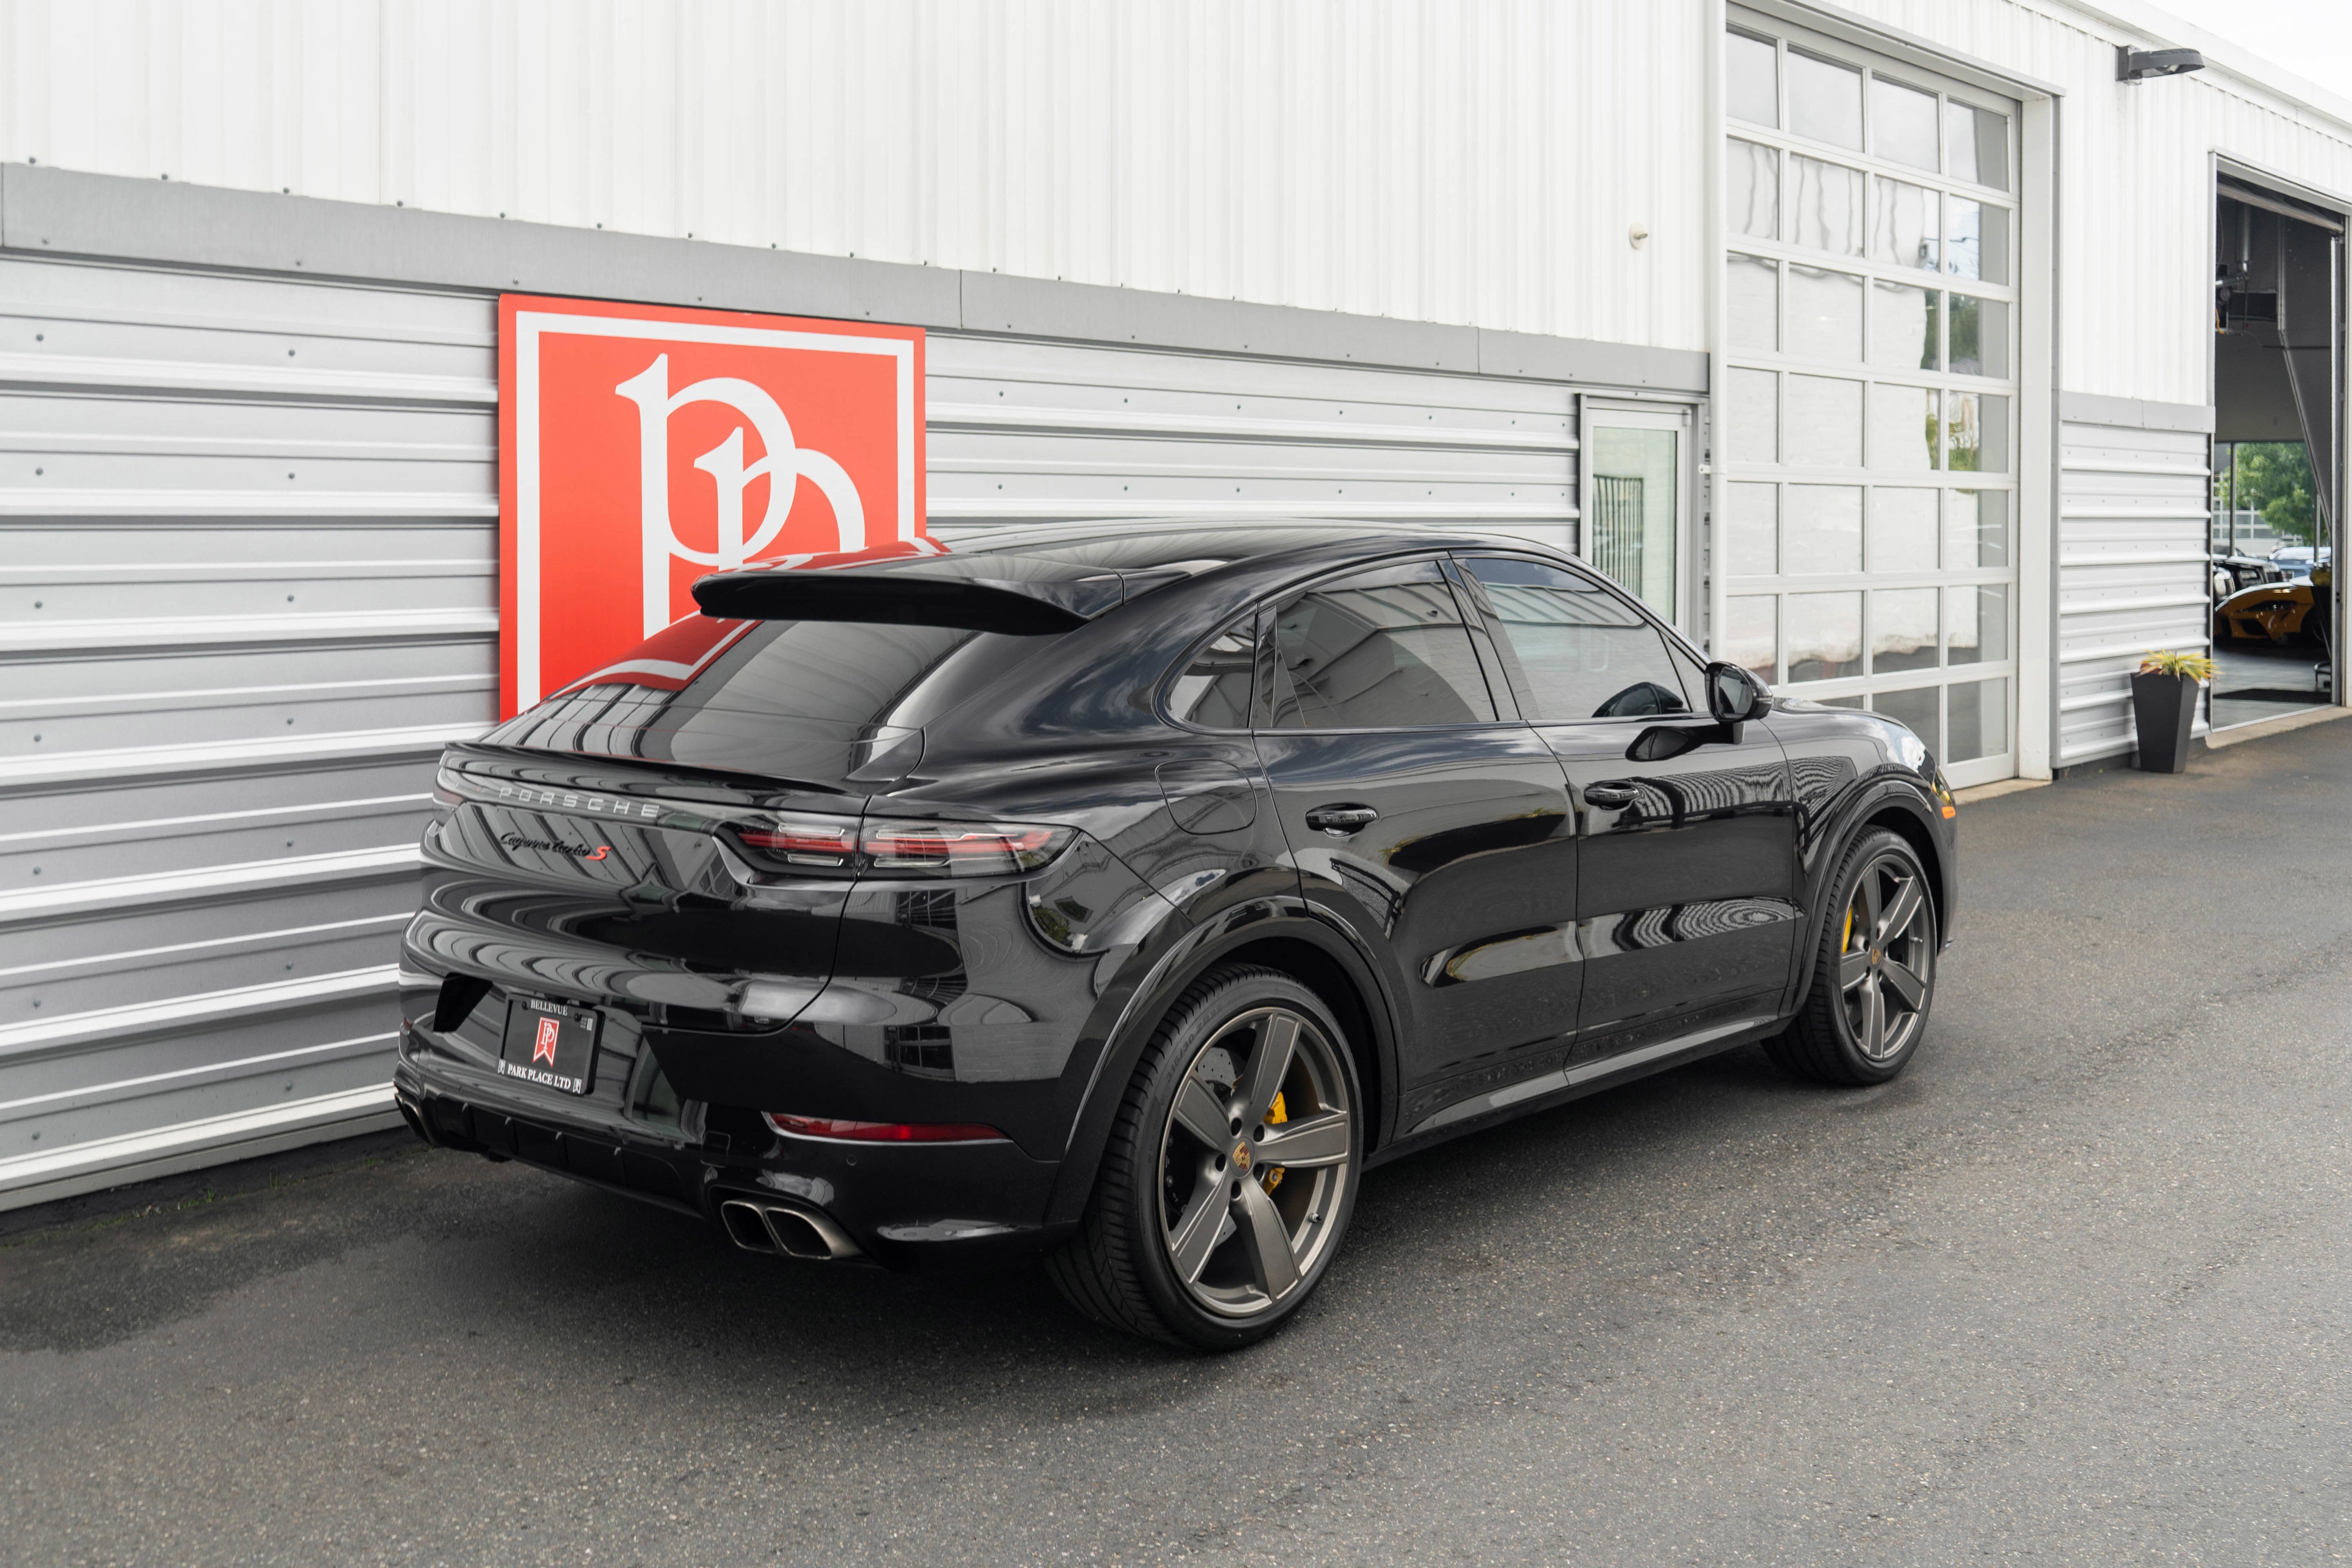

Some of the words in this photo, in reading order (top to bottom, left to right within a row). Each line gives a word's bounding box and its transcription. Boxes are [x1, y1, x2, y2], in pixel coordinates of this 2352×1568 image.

[499, 786, 659, 817] PORSCHE
[500, 832, 550, 851] Cayenne
[586, 846, 611, 861] S
[531, 999, 568, 1016] BELLEVUE
[507, 1064, 527, 1079] PARK
[527, 1069, 553, 1085] PLACE
[554, 1075, 571, 1089] LTD
